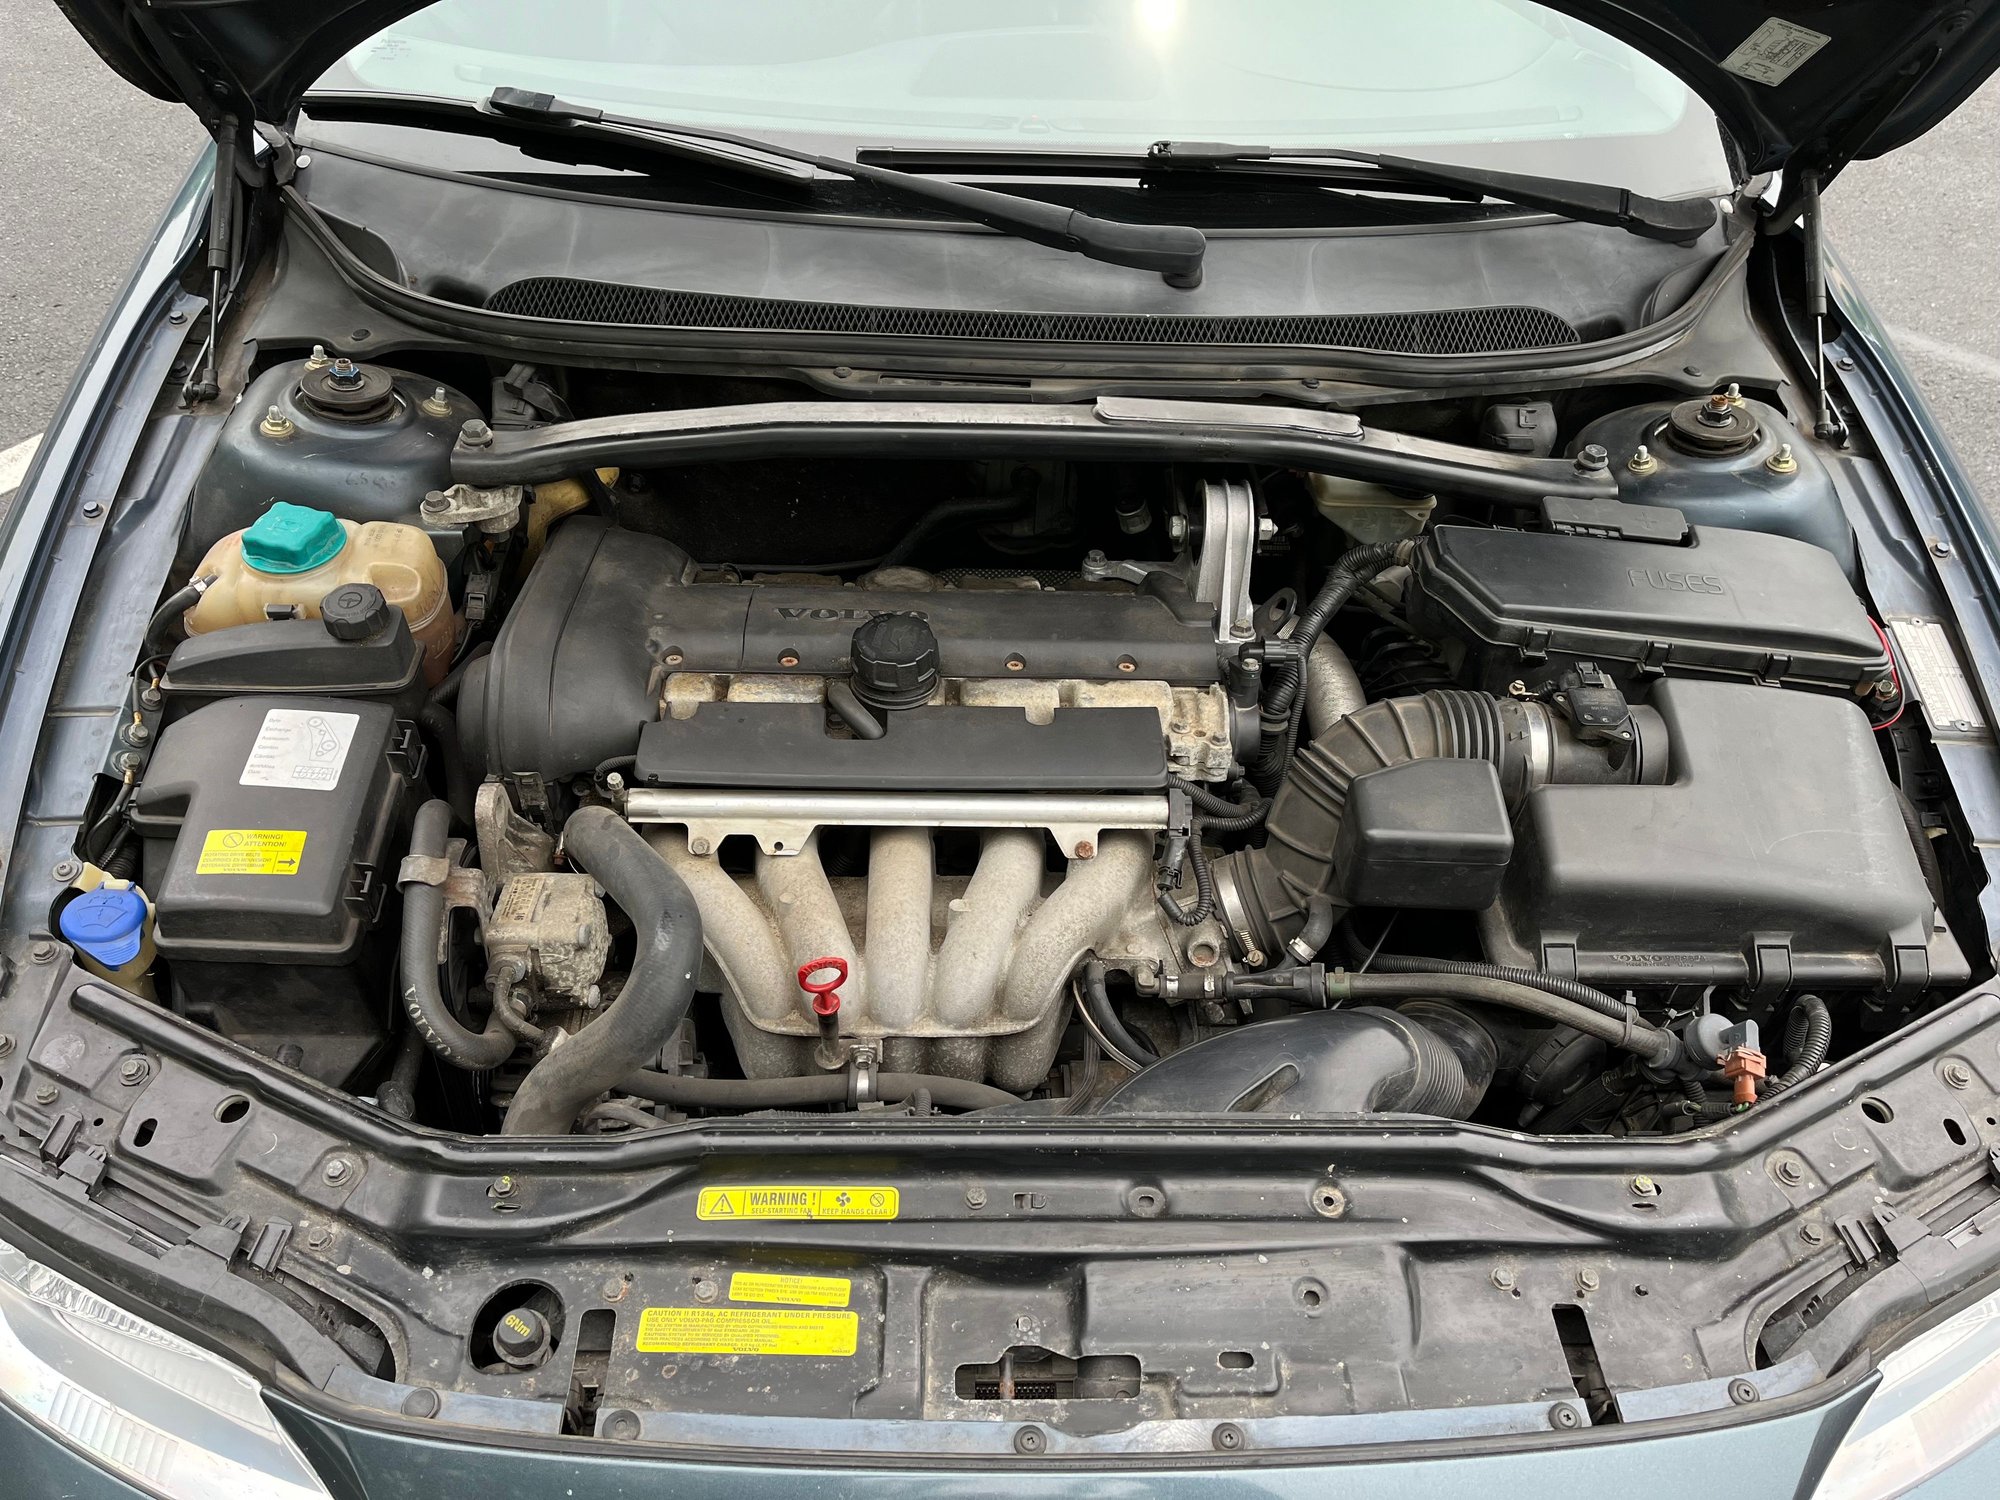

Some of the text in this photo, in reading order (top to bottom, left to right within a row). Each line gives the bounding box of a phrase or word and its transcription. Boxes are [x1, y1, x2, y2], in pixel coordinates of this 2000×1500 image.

[1627, 569, 1724, 594] FUSES
[404, 983, 452, 1055] VOLVO
[750, 1192, 807, 1206] WARNING
[505, 1314, 531, 1337] 6Nm
